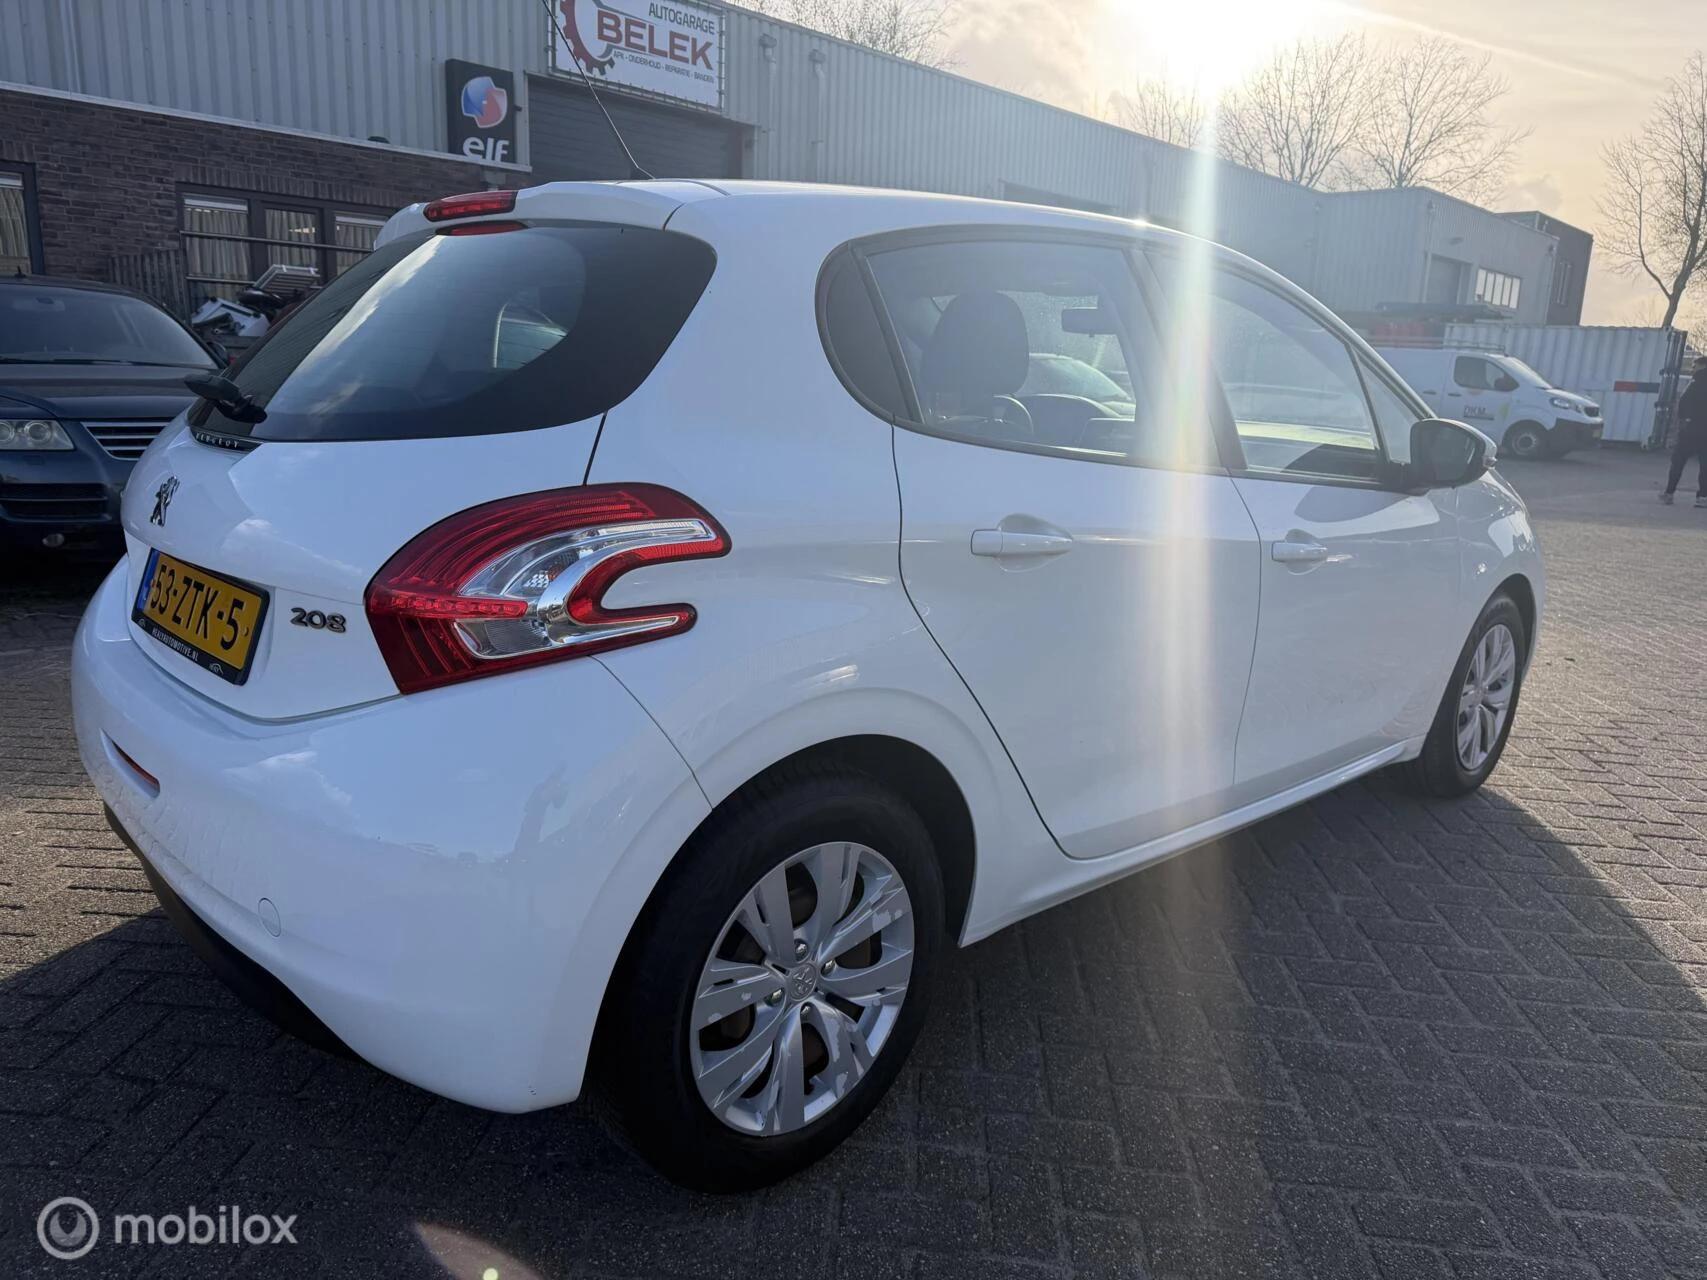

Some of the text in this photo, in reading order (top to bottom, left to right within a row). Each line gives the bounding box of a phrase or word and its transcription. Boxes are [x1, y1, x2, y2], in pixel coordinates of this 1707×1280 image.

[648, 2, 715, 35] AUTOGARAGE
[597, 9, 713, 71] BELEK
[462, 136, 510, 162] elf
[150, 564, 245, 651] 53-ZTK-5
[290, 606, 347, 634] 208
